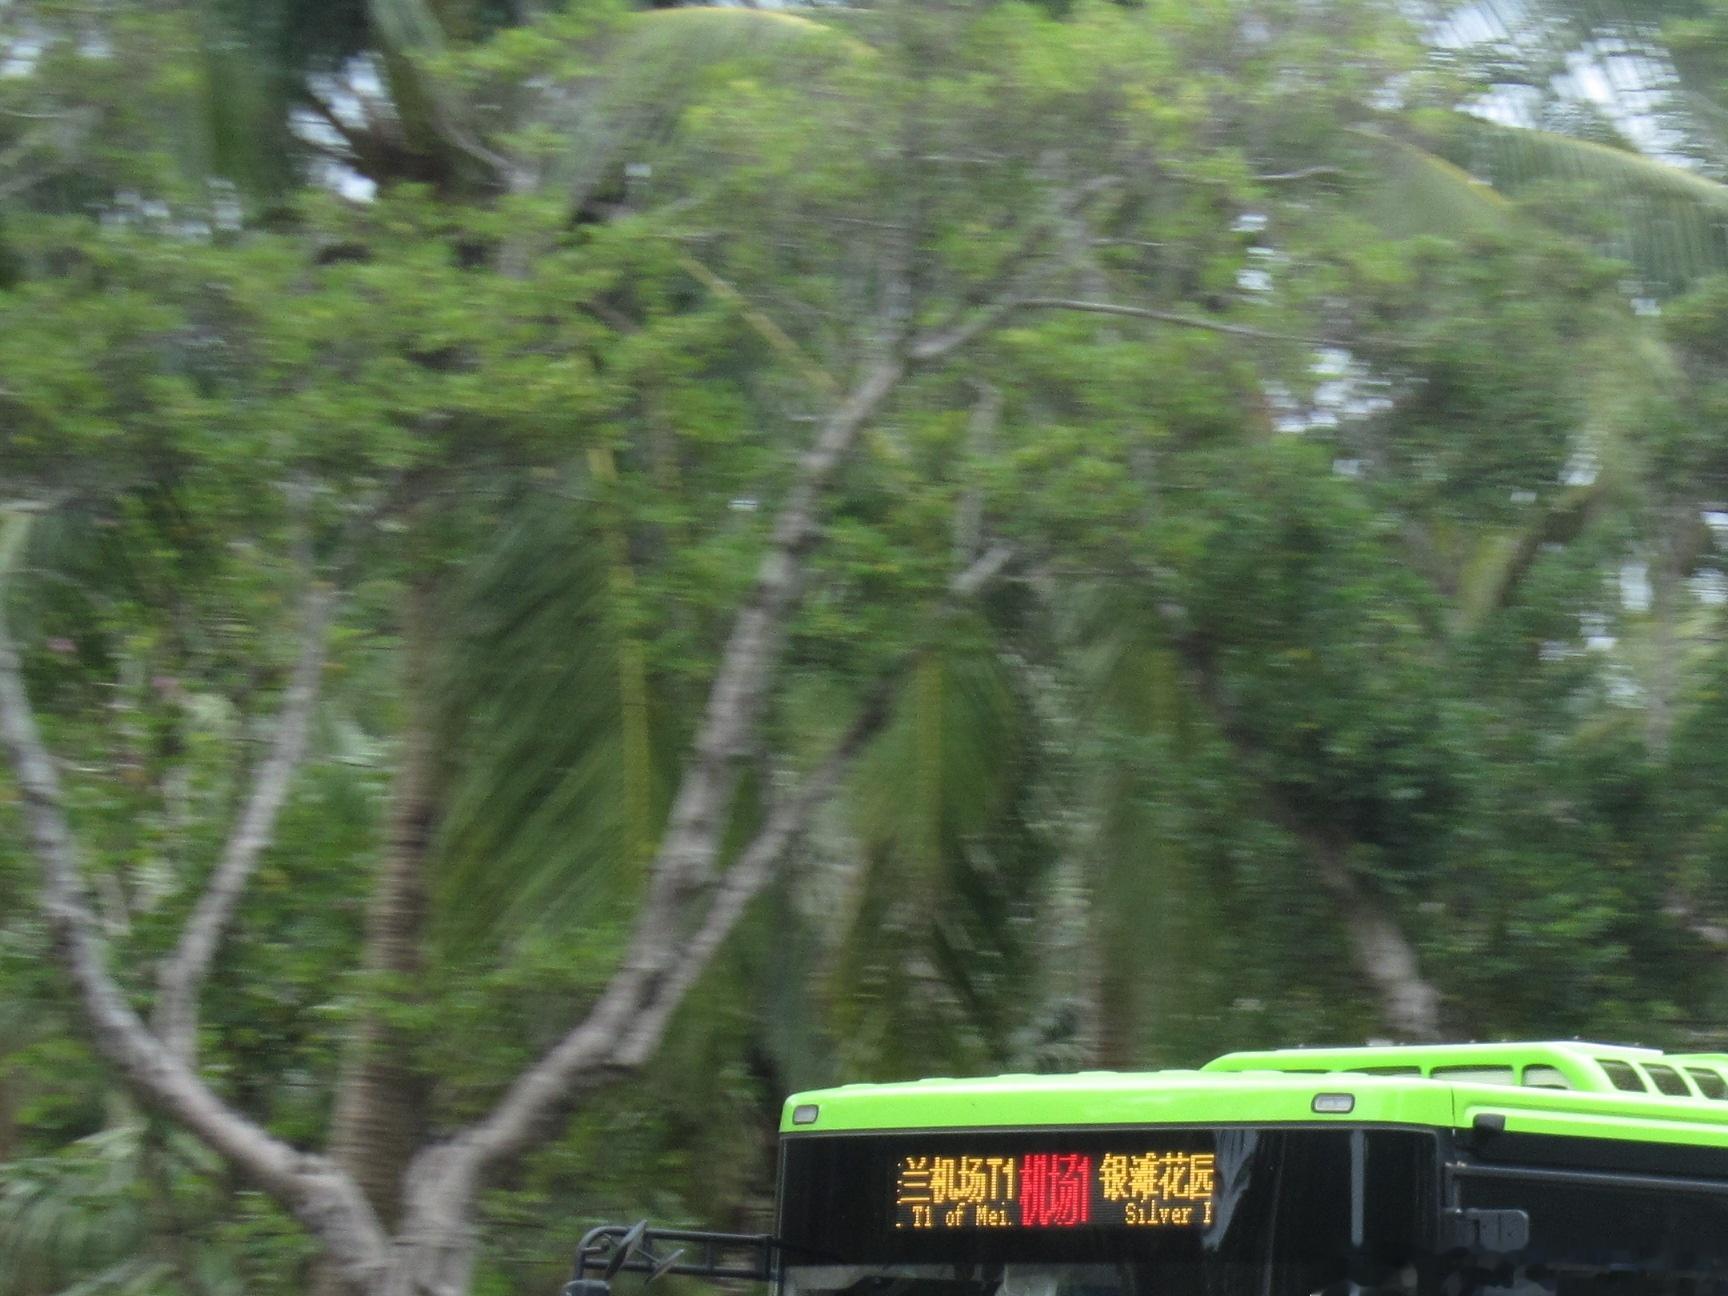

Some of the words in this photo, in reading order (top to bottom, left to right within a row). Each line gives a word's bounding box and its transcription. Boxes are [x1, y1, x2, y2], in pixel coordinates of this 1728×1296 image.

[1099, 1152, 1215, 1200] 银滩花园
[911, 1206, 931, 1227] T1
[945, 1202, 966, 1227] of
[1125, 1199, 1193, 1225] Silver
